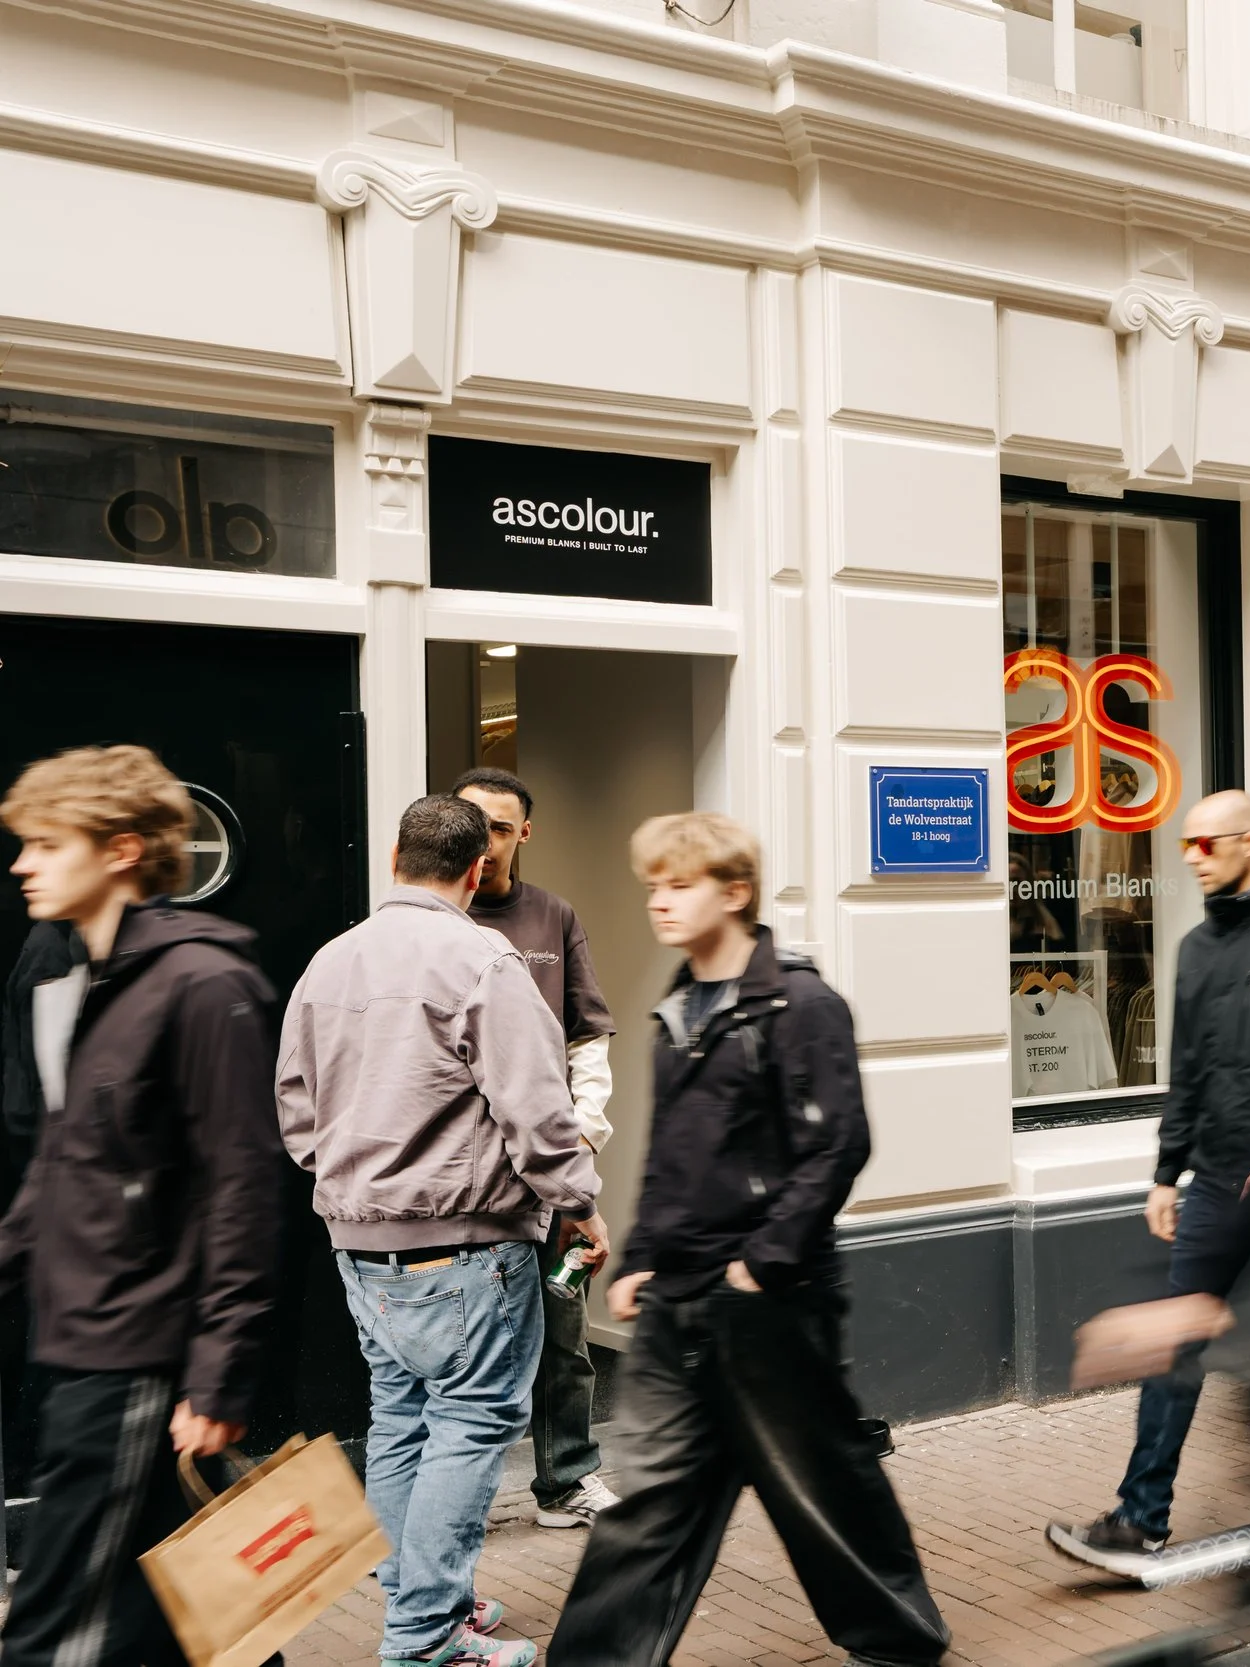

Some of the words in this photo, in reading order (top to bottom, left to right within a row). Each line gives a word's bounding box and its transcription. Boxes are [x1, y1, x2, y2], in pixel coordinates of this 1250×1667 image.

[492, 497, 659, 538] ascolour.
[504, 534, 545, 546] PREMIUM
[547, 538, 581, 549] BLANKS
[589, 542, 612, 551] BUILT
[614, 544, 625, 552] TO
[627, 545, 648, 554] LAST
[1003, 648, 1183, 834] as
[886, 796, 974, 810] Tandartspraktijk
[888, 814, 902, 825] de
[904, 814, 972, 825] Wolvenstraat
[911, 832, 928, 841] 18-1
[929, 831, 951, 842] hoog
[1009, 874, 1098, 900] remium
[1106, 873, 1179, 898] Blanks
